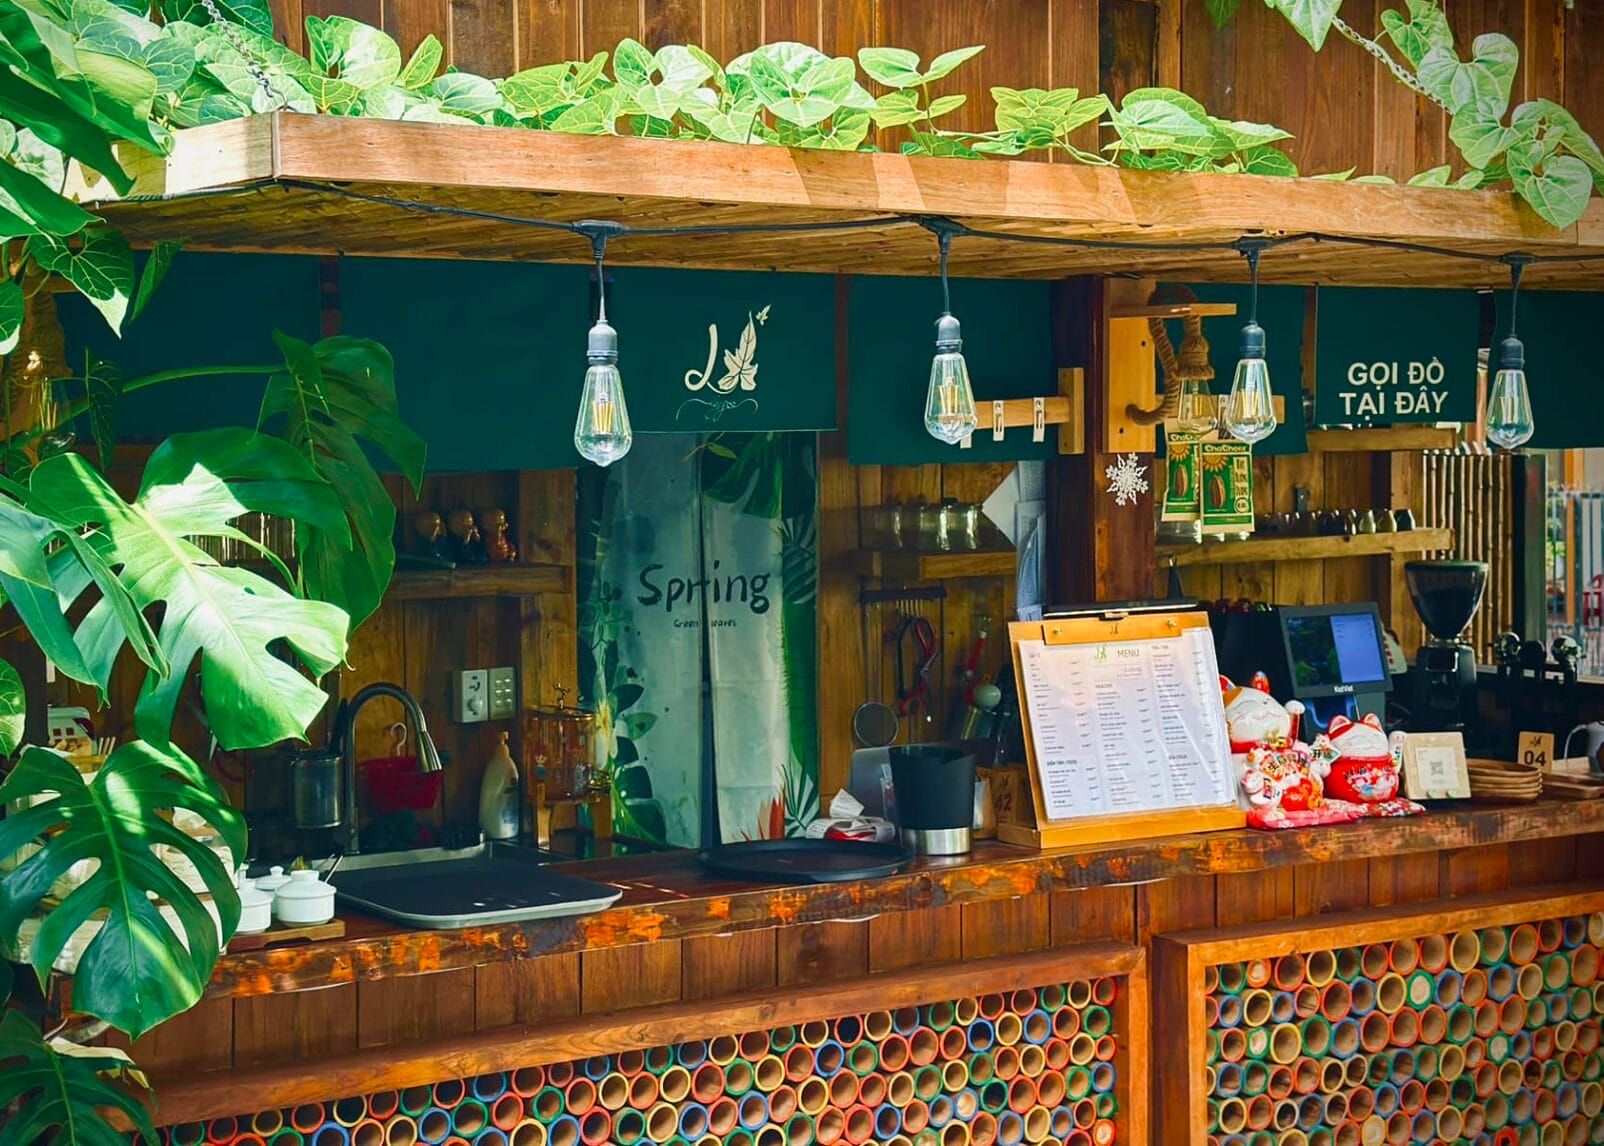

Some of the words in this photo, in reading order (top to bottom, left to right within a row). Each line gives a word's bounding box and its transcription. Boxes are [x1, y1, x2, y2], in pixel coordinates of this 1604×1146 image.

[1347, 361, 1398, 390] GỌI
[1338, 391, 1385, 421] TẠI
[1394, 385, 1449, 414] ĐÂY
[637, 560, 771, 614] Spring
[674, 619, 699, 628] Green
[1117, 648, 1140, 658] MENU
[1524, 750, 1547, 767] 04
